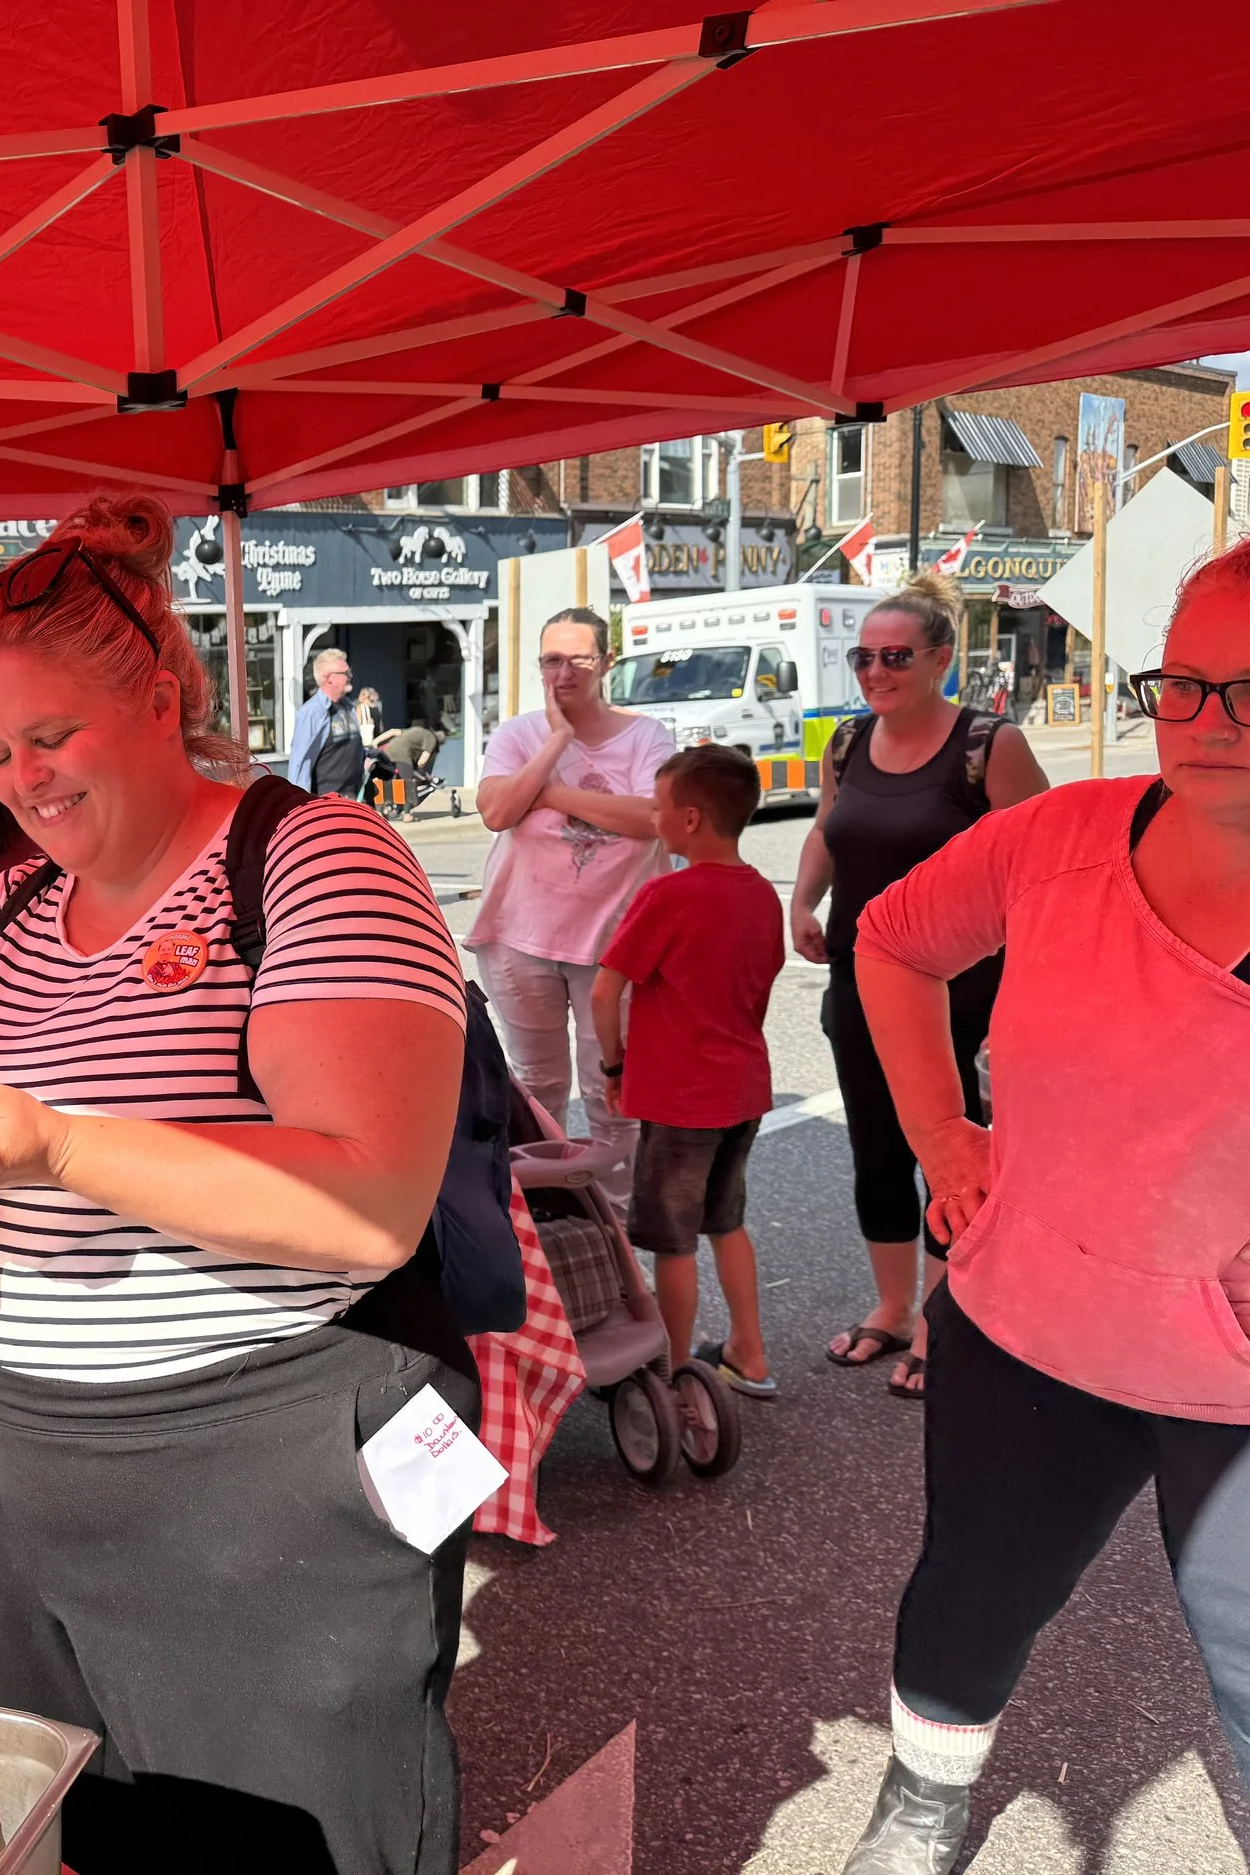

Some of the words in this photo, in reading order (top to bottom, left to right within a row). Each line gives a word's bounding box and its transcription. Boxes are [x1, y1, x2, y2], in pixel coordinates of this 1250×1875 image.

[710, 543, 781, 577] PNNY
[256, 567, 302, 597] Tyme
[370, 567, 401, 587] Two
[402, 567, 440, 586] Horse
[440, 567, 490, 588] Gallery
[175, 945, 200, 957] LEAF
